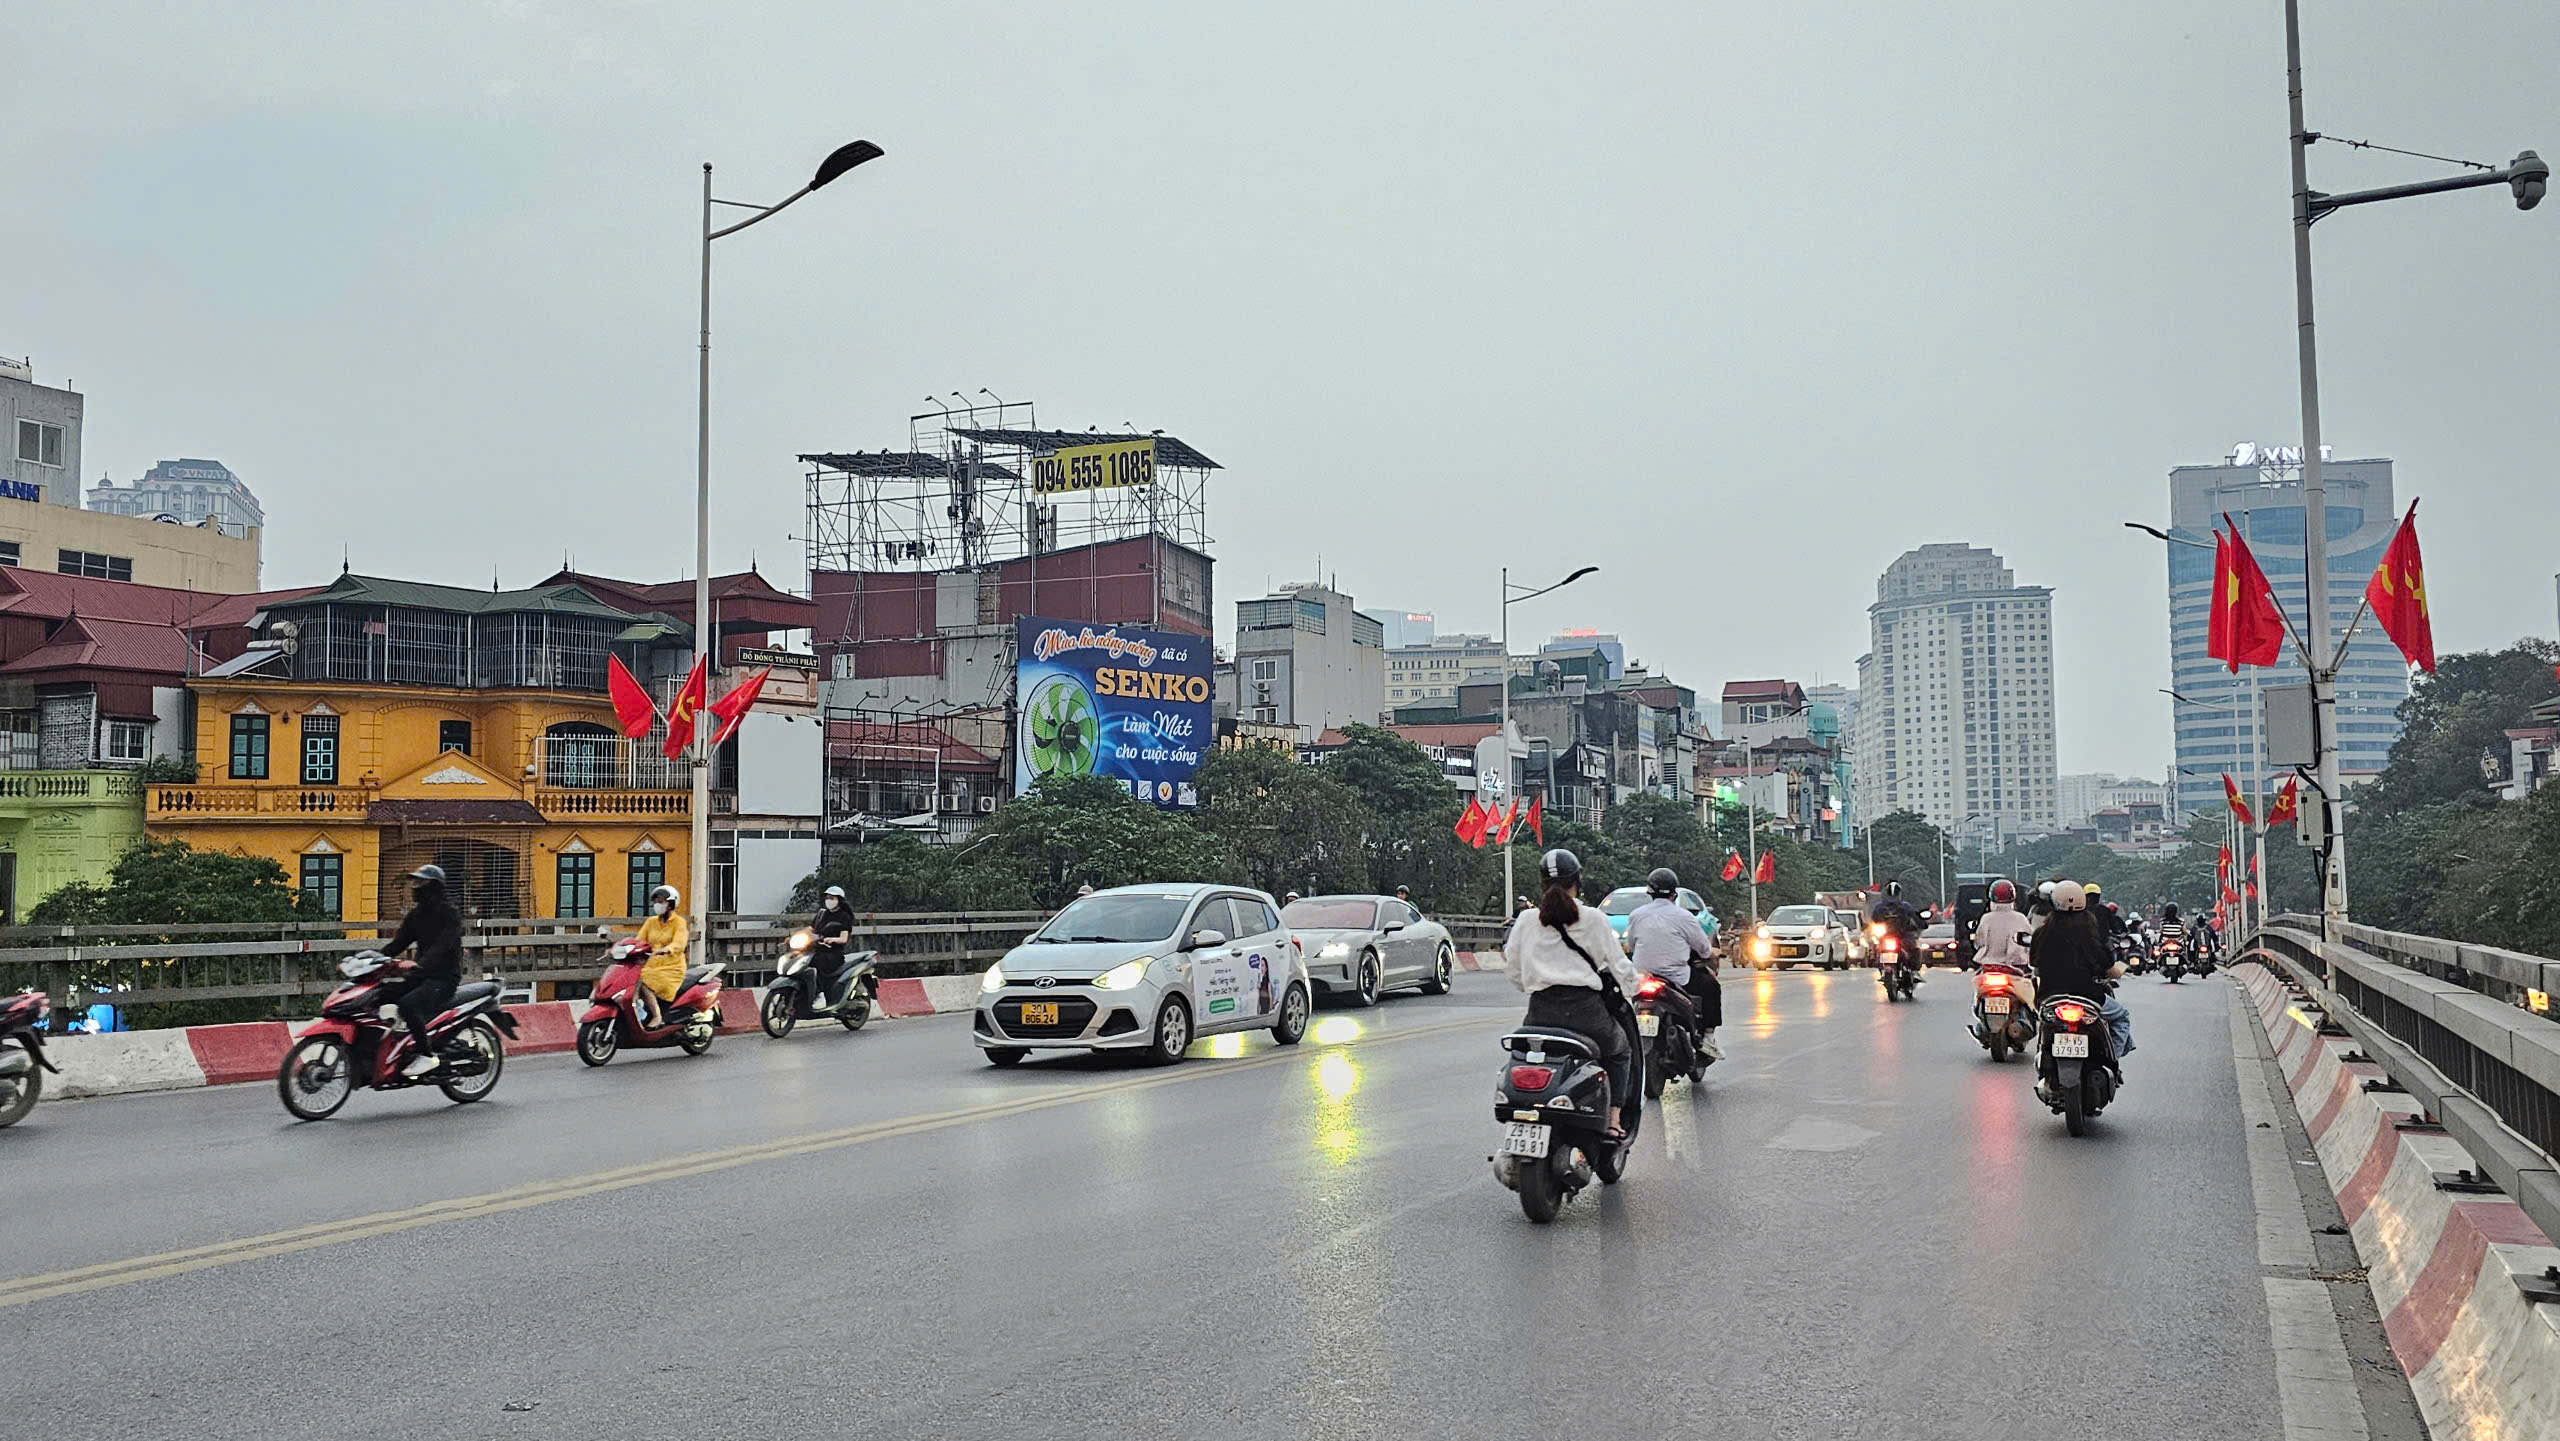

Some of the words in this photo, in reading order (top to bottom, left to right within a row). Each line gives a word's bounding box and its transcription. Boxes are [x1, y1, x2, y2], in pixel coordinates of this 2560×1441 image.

[2264, 445, 2332, 461] VNT
[1035, 459, 1066, 492] 094
[1071, 455, 1103, 489] 555
[1108, 450, 1152, 486] 1085
[1034, 629, 1078, 661] Mùa
[1078, 627, 1095, 651] hè
[1094, 629, 1127, 659] nắng
[1125, 639, 1157, 667] nóng
[1161, 648, 1174, 660] đã
[1176, 648, 1188, 661] có
[1095, 666, 1209, 703] SENKO
[1123, 716, 1150, 733] Làm
[1153, 710, 1193, 737] Mát
[1115, 743, 1138, 759] cho
[1141, 743, 1168, 764] cuộc
[1170, 744, 1197, 766] sống
